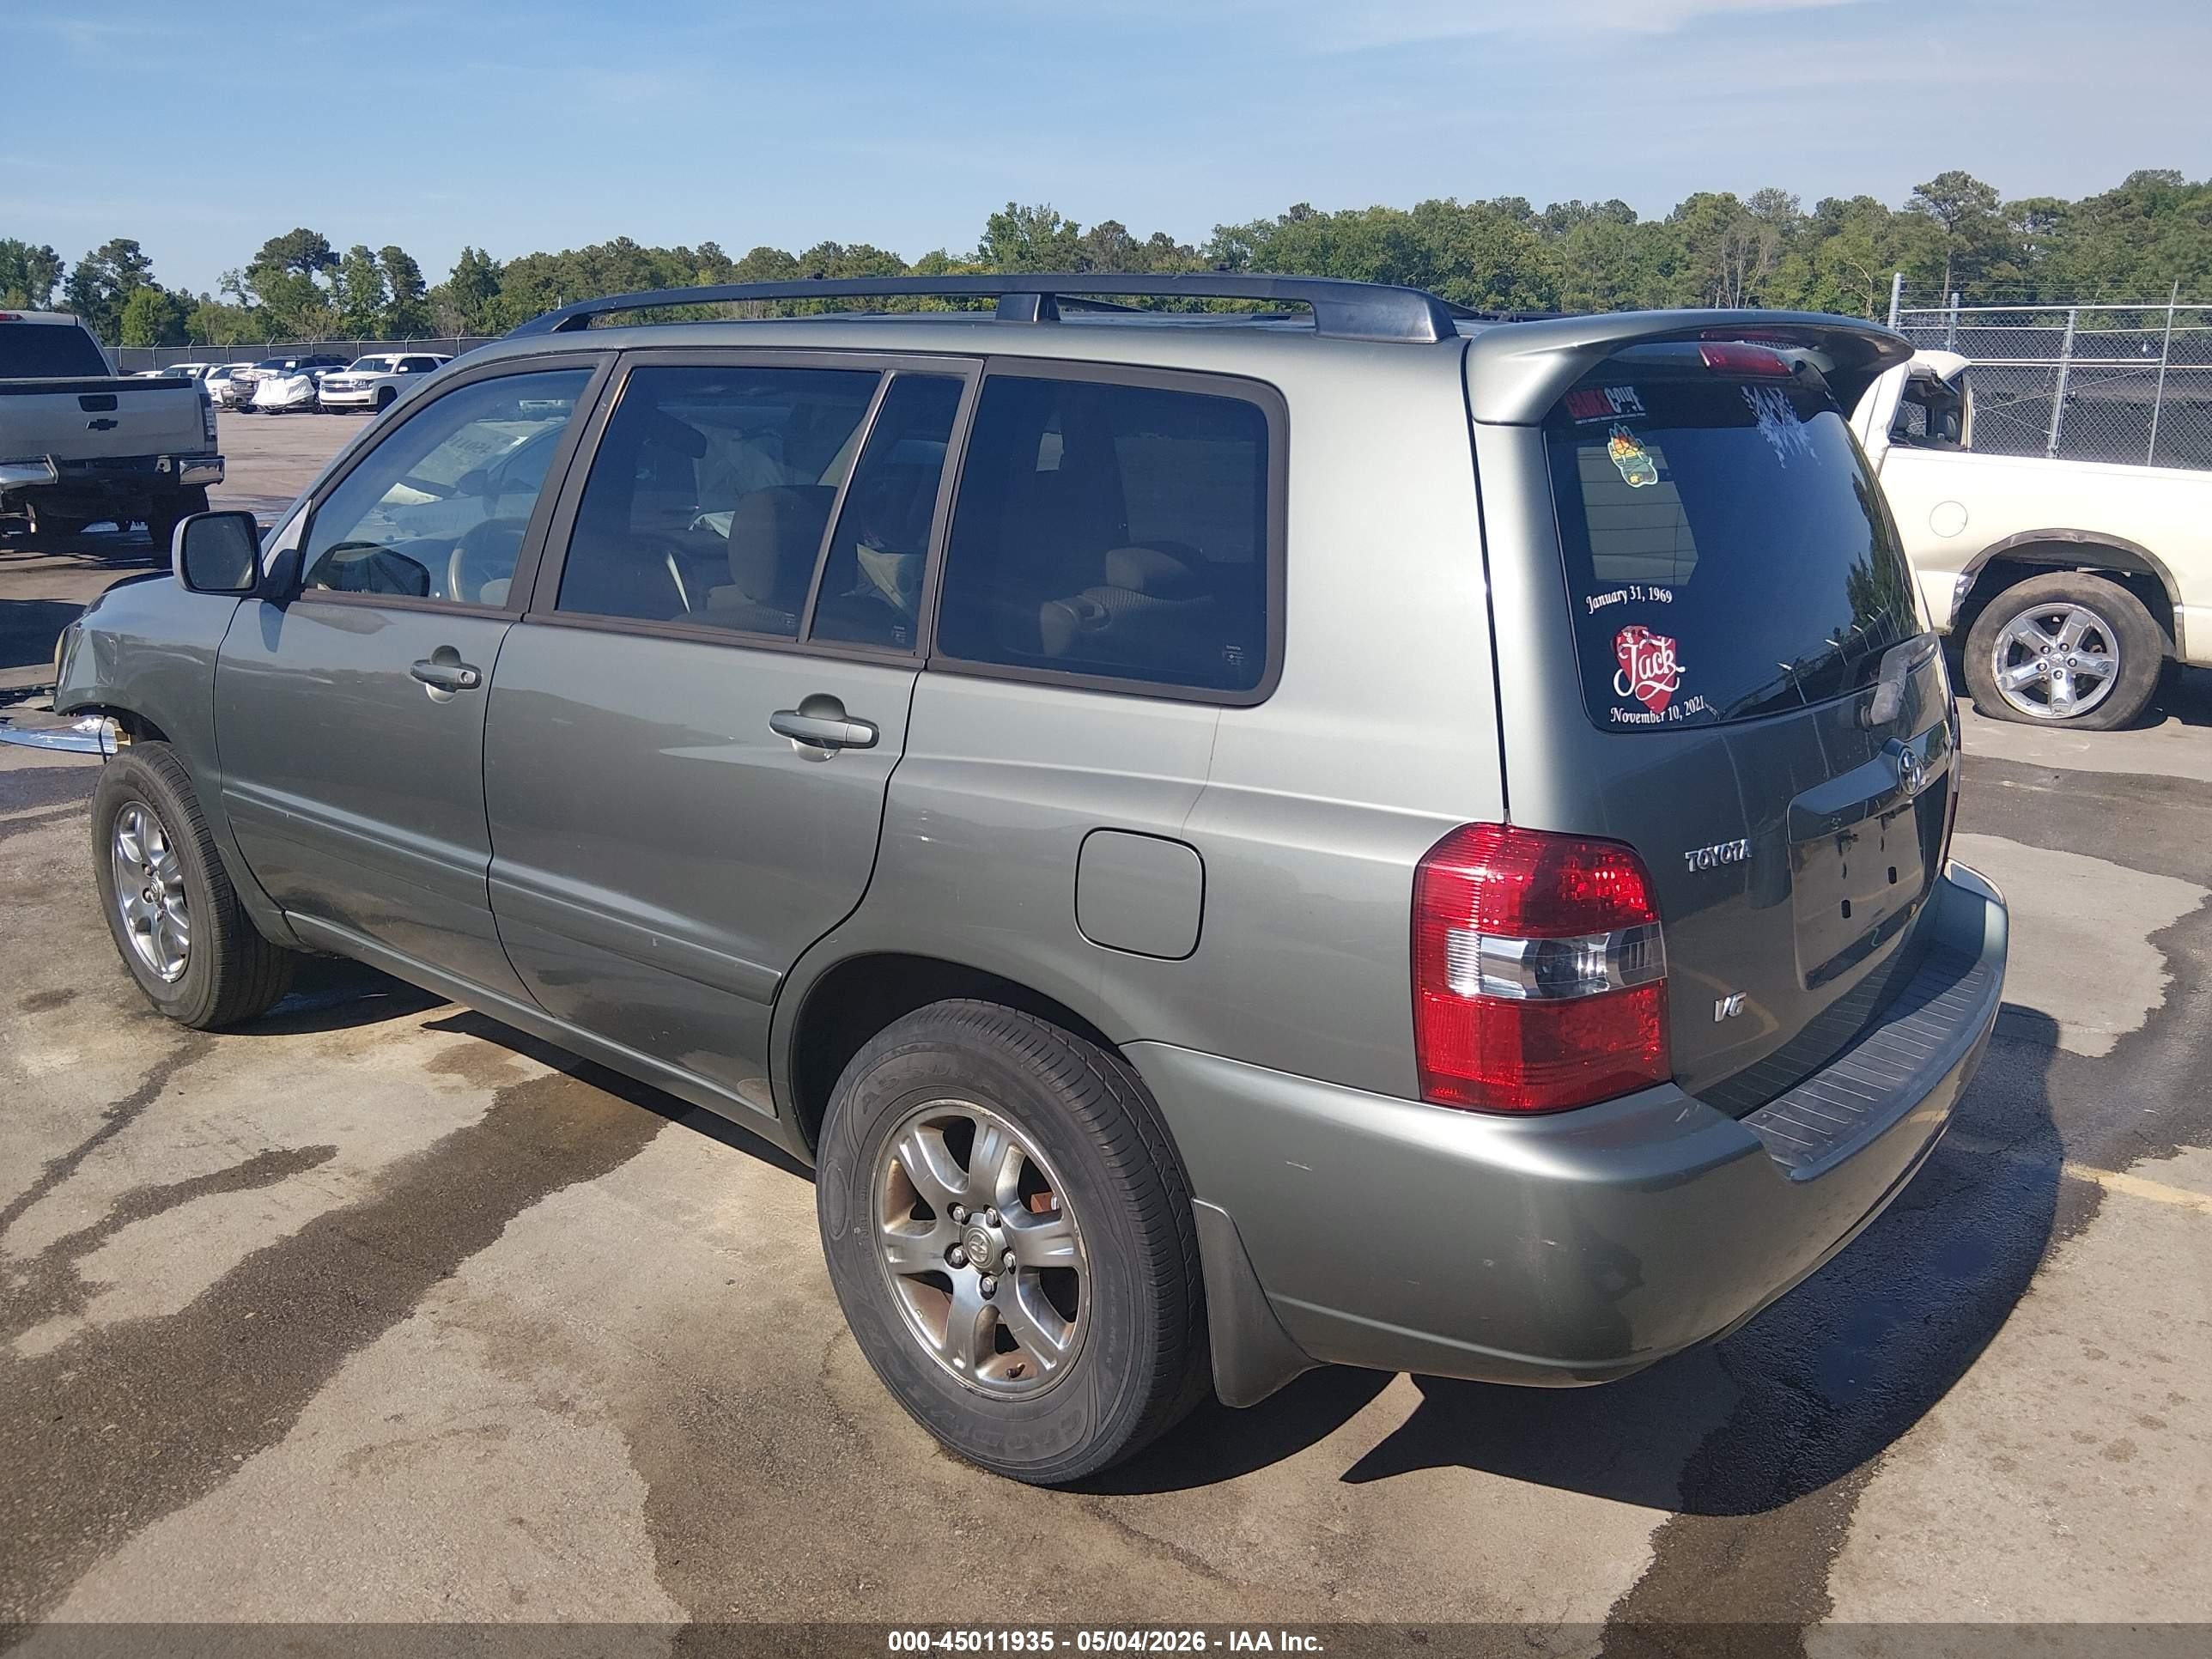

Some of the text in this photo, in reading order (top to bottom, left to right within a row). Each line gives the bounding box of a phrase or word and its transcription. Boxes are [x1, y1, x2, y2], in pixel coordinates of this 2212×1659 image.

[1586, 586, 1673, 614] January 31, 1969
[1613, 636, 1686, 701] Jack
[1610, 695, 1705, 724] November 10, 2021
[1685, 838, 1753, 872] TOYOTA
[1714, 992, 1747, 1023] V6
